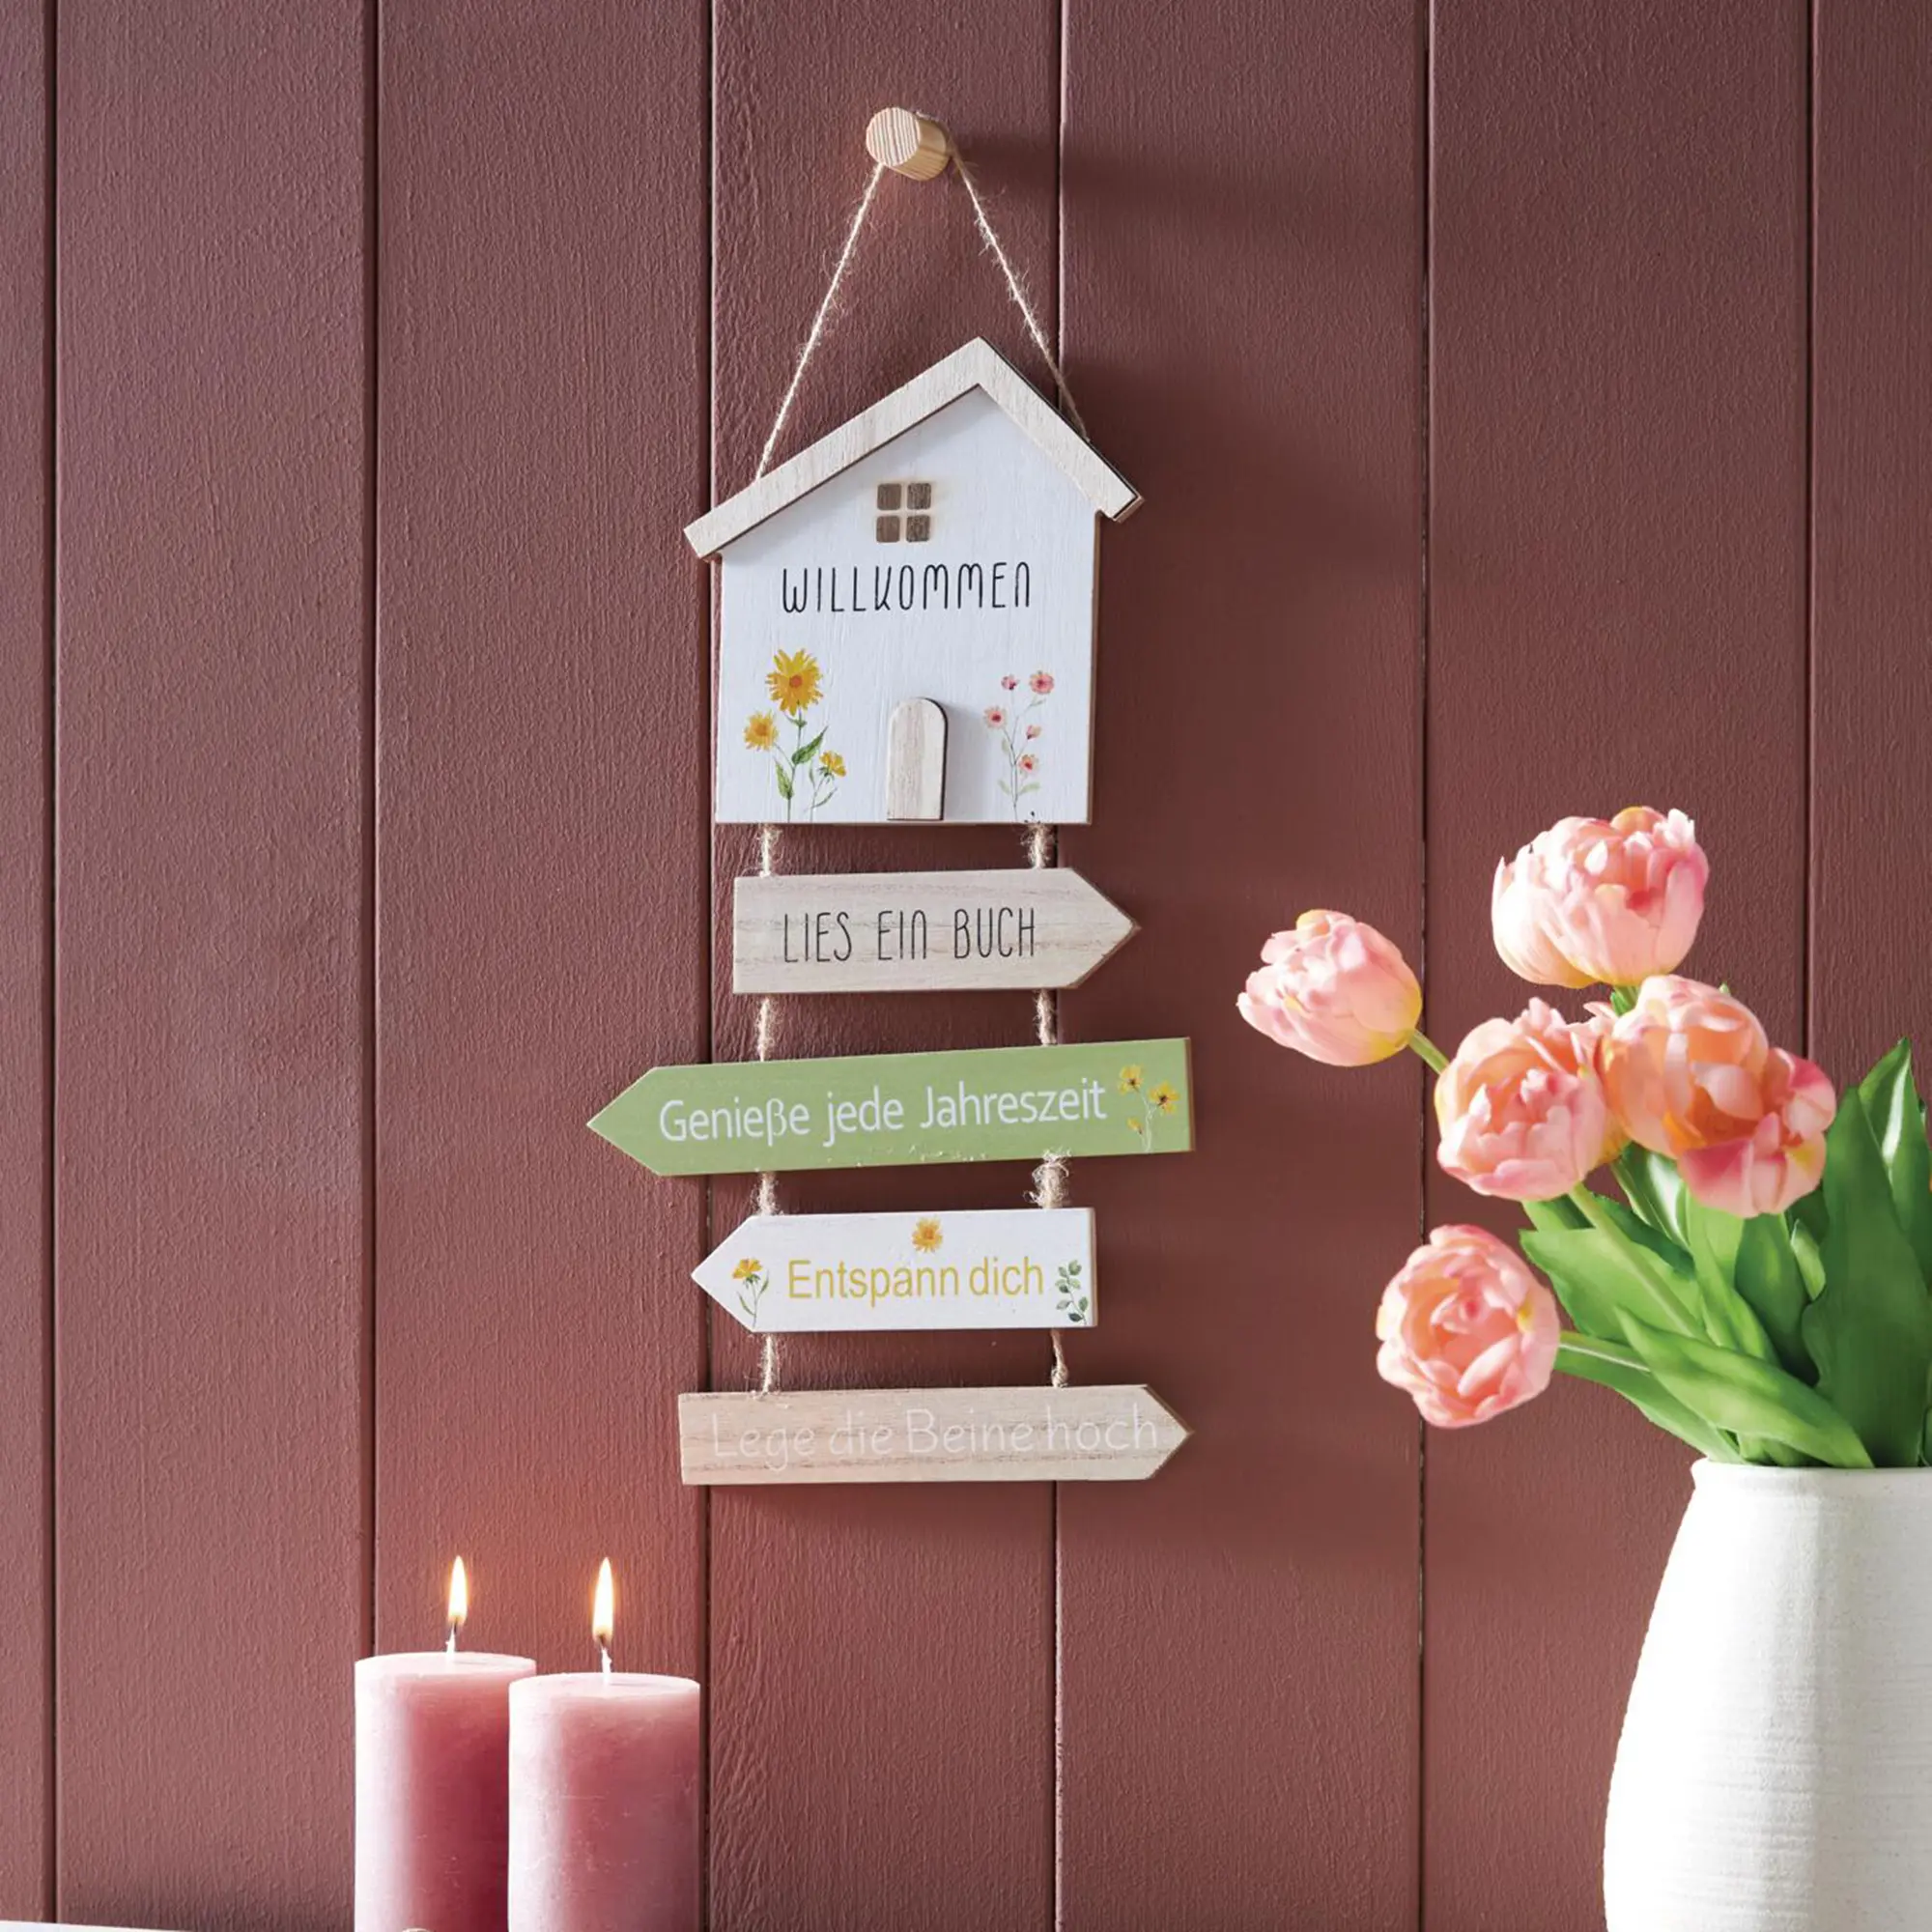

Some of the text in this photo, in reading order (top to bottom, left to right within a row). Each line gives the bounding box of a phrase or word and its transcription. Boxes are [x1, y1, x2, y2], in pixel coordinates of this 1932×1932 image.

[781, 561, 1031, 613] WILLKOMMEN
[783, 906, 1036, 963] LIES EIN BUCH
[658, 1076, 1108, 1147] Genieße jede Jahreszeit
[787, 1255, 1044, 1307] Entspann dich
[711, 1402, 1158, 1472] Lege die Beine hoch
